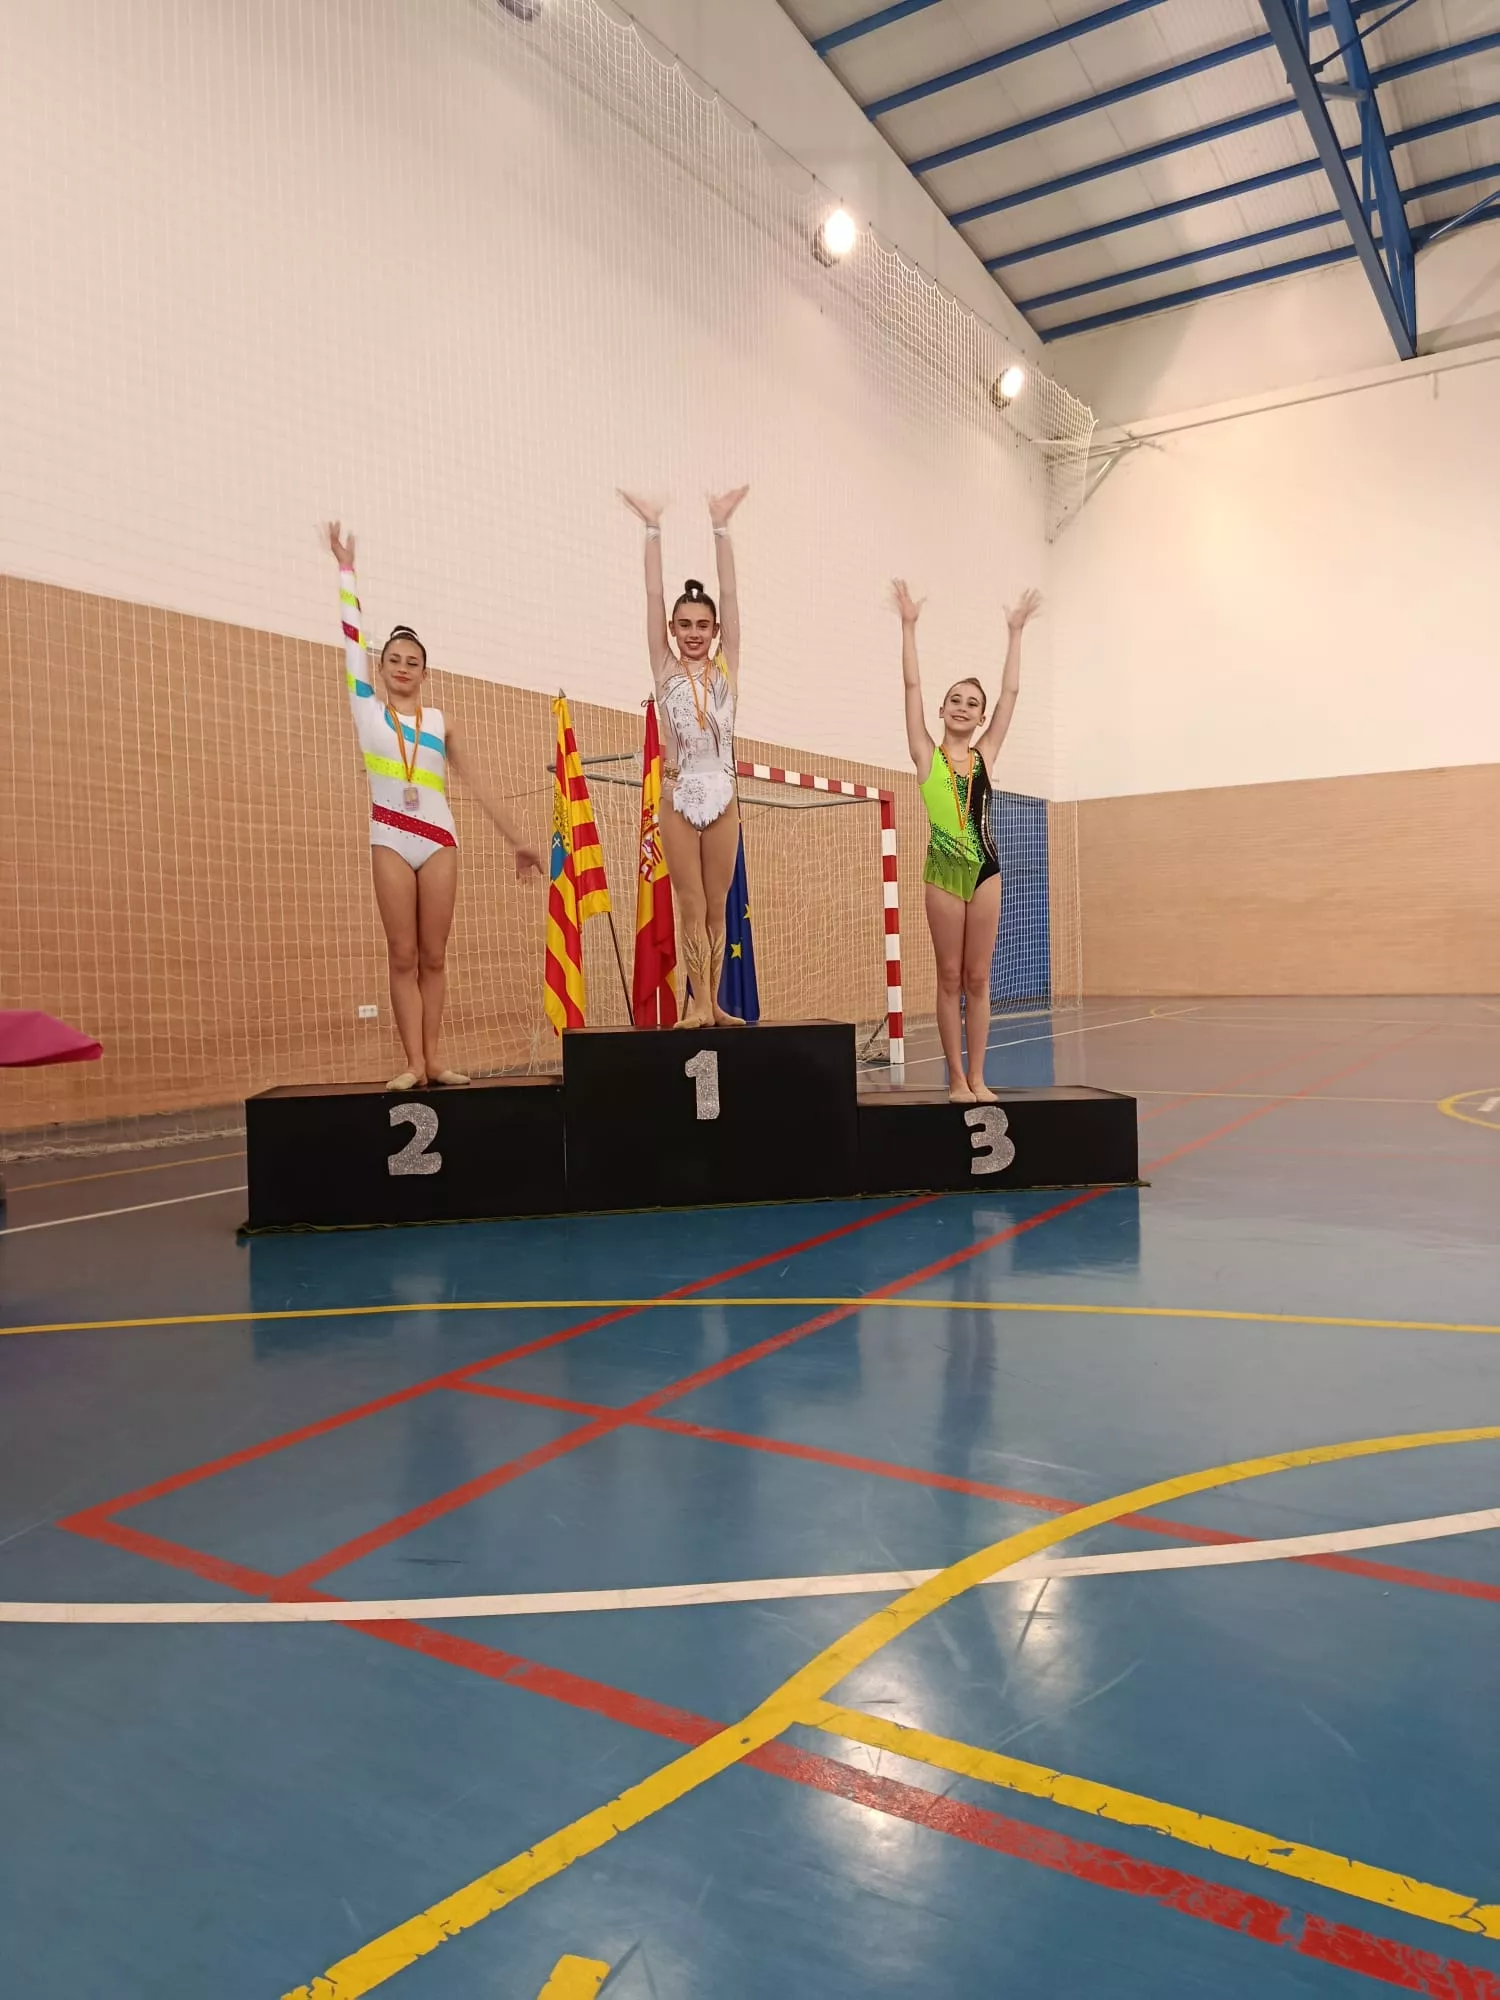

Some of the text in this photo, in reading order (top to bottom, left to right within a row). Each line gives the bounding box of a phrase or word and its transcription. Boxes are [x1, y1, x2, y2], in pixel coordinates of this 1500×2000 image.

[685, 1050, 720, 1121] 1
[387, 1102, 442, 1175] 2
[964, 1105, 1016, 1175] 3
